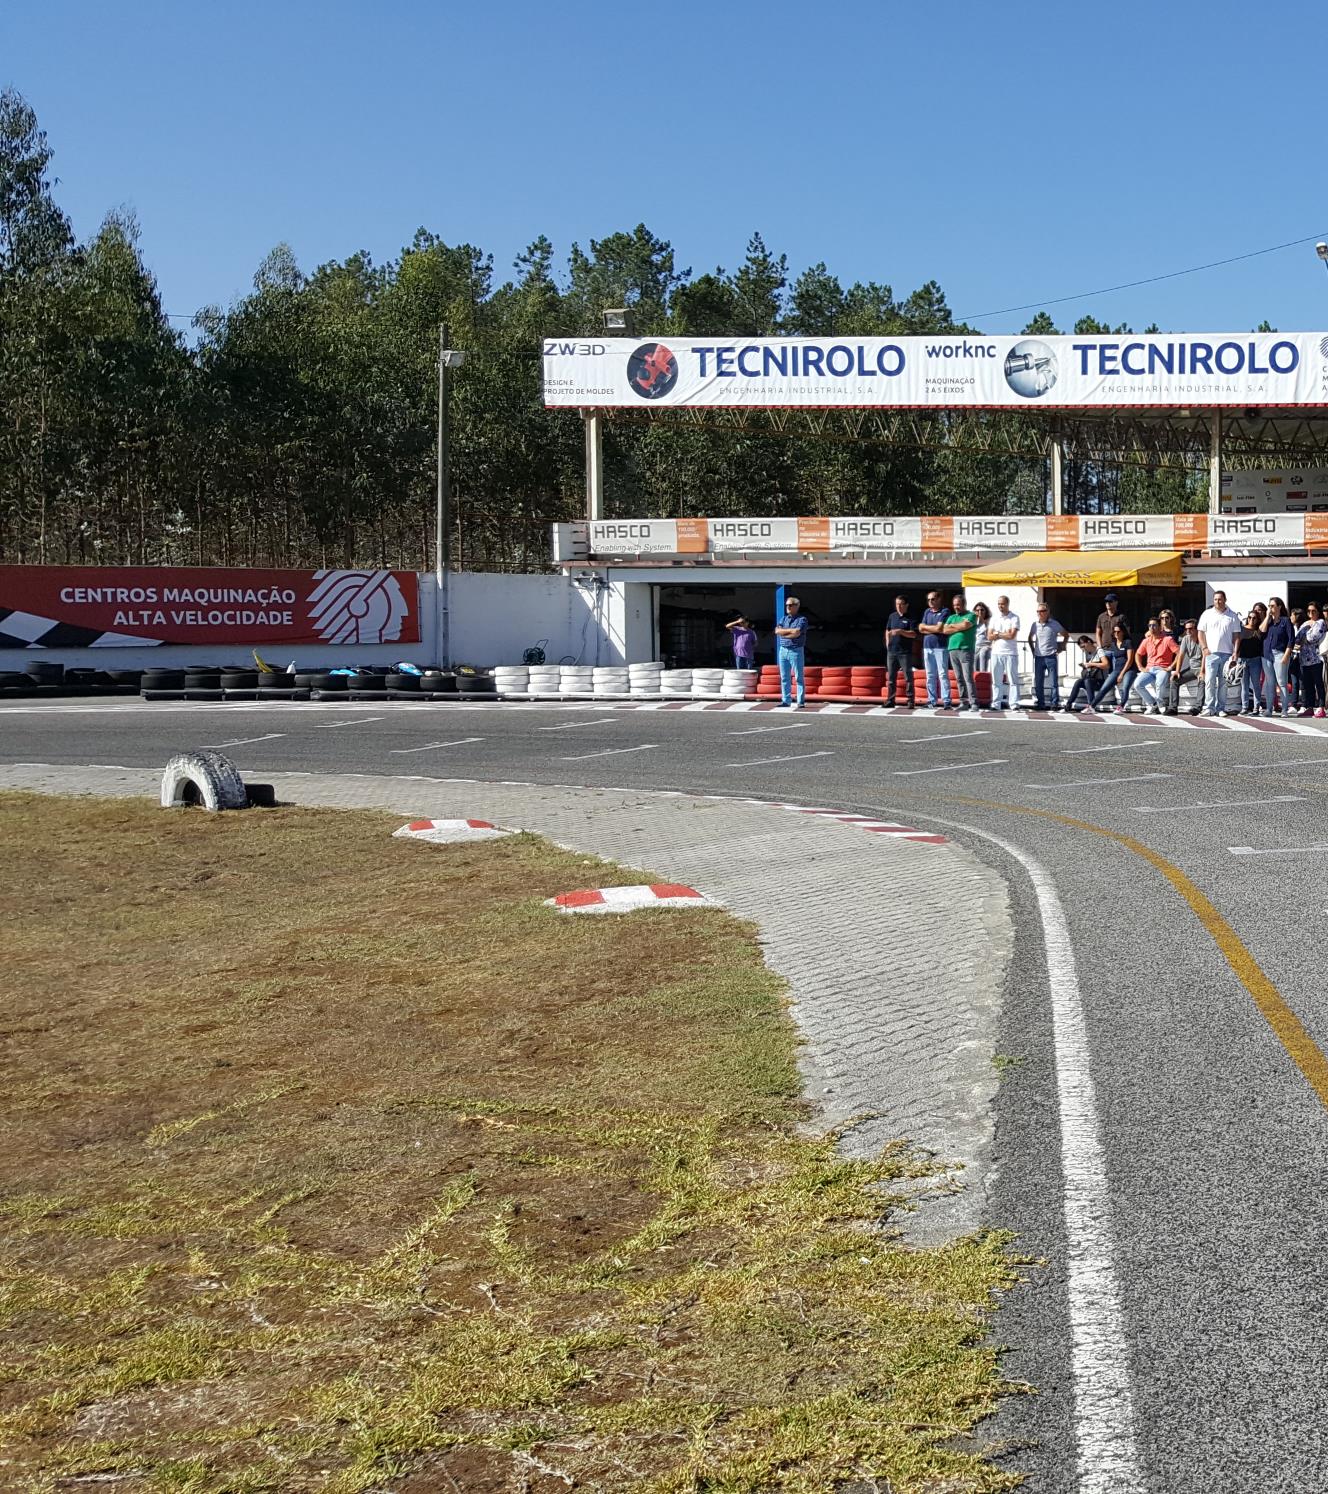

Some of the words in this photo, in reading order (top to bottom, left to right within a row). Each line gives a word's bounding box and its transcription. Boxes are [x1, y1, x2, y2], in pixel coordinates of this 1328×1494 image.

[544, 343, 606, 356] ZW3D
[925, 339, 997, 358] worknc
[691, 344, 906, 377] TECNIROLO
[1072, 341, 1300, 376] TECNIROLO
[925, 377, 976, 386] MAQUINAÇÃO
[1102, 384, 1170, 393] ENGENHARIA
[719, 386, 784, 395] ENGENHARIA
[943, 386, 965, 394] EIXOS
[594, 525, 651, 539] HASCO
[713, 523, 772, 537] HASCO
[835, 522, 895, 536] HASCO
[959, 521, 1019, 535] HASCO
[1084, 520, 1146, 534] HASCO
[1213, 518, 1276, 533] HASCO
[60, 587, 158, 604] CENTROS
[163, 586, 296, 607] MAQUINAÇÃO
[113, 610, 167, 626] ALTA
[171, 610, 293, 626] VELOCIDADE
